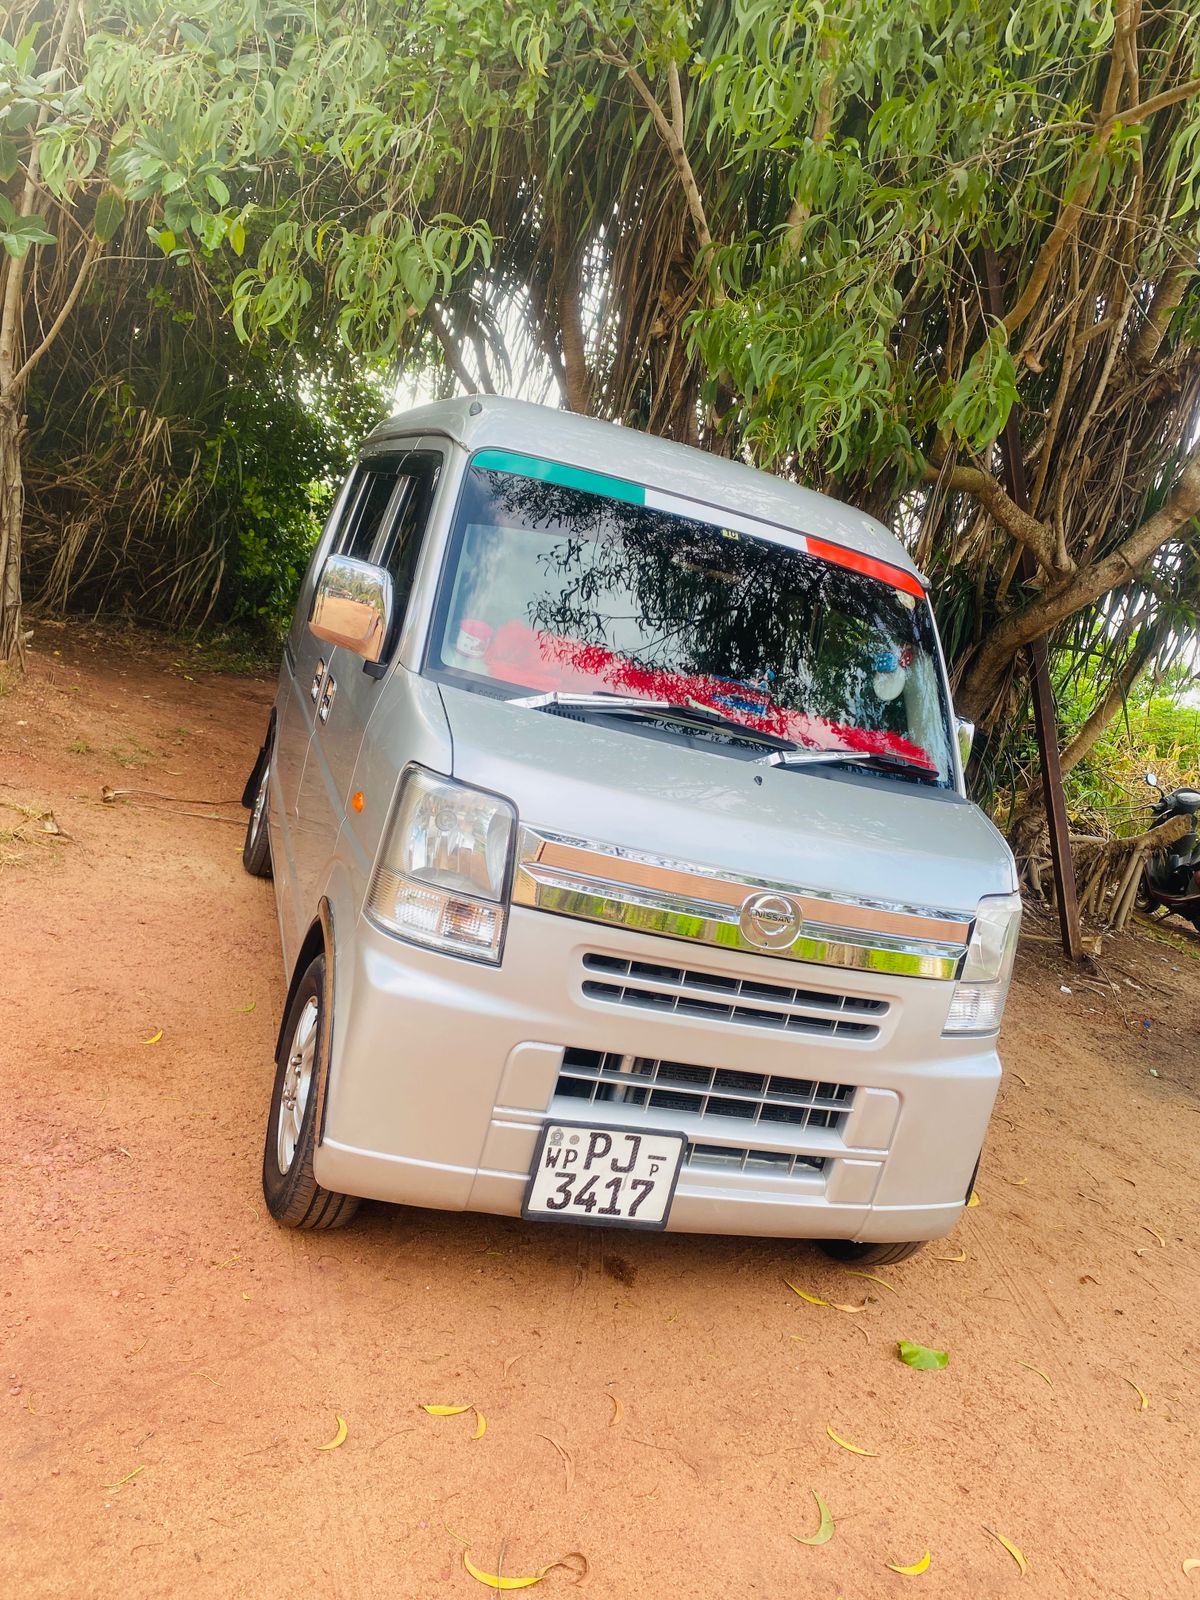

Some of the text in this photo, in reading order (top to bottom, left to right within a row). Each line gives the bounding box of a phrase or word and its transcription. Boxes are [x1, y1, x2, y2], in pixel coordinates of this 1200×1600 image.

[755, 910, 791, 924] NISSAN
[545, 1147, 579, 1169] WP
[583, 1132, 642, 1174] PJ
[546, 1171, 655, 1217] 3417
